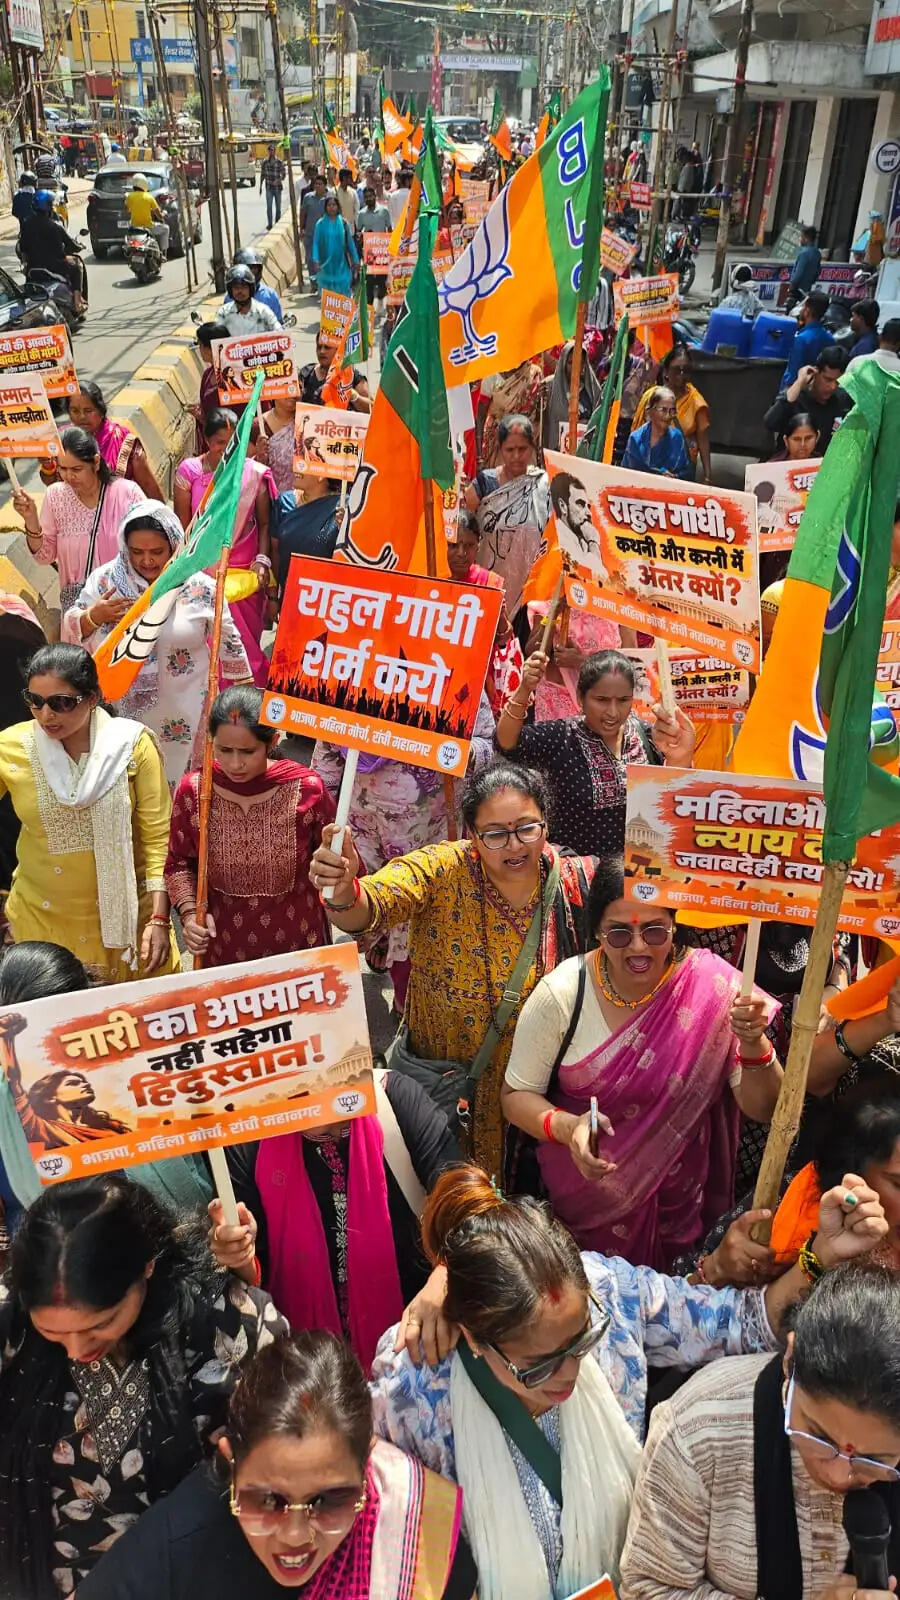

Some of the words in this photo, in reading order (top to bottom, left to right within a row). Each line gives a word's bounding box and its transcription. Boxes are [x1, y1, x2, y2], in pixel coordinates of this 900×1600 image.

[314, 420, 352, 438] महिला
[607, 494, 667, 534] राहुल
[668, 497, 736, 544] गांधी,
[615, 535, 657, 558] कथनी
[660, 538, 685, 562] और
[688, 544, 727, 569] करनी
[730, 548, 744, 572] में
[638, 561, 684, 593] अंतर
[686, 571, 742, 607] क्यों?
[298, 577, 392, 633] राहुल
[394, 589, 485, 648] गांधी
[302, 639, 374, 688] शर्म
[373, 653, 451, 706] करो
[675, 687, 704, 700] अंतर
[706, 683, 739, 698] क्यों?
[290, 709, 317, 729] भाजपा,
[319, 716, 346, 736] महिला
[348, 723, 370, 744] मोर्चा,
[372, 729, 391, 746] रांची
[391, 736, 432, 757] महानगर
[694, 824, 798, 857] न्याय
[674, 851, 779, 878] जवाबदेही
[784, 862, 825, 882] तय
[845, 866, 885, 892] रो!
[667, 890, 707, 907] भाजपा,
[710, 895, 749, 910] महिला
[751, 900, 782, 917] मोर्चा,
[785, 904, 811, 919] रांची
[60, 1014, 140, 1060] नारी
[143, 1005, 200, 1042] का
[203, 972, 337, 1028] अपमान,
[148, 1040, 206, 1073] नहीं
[211, 1020, 293, 1060] सहेगा
[127, 1034, 326, 1108] हिंदुस्तान!
[81, 1144, 135, 1167] भाजपा,
[138, 1134, 186, 1155] महिला
[189, 1122, 228, 1146] मोर्चा,
[229, 1115, 260, 1136] रांची
[262, 1105, 323, 1129] महानगर
